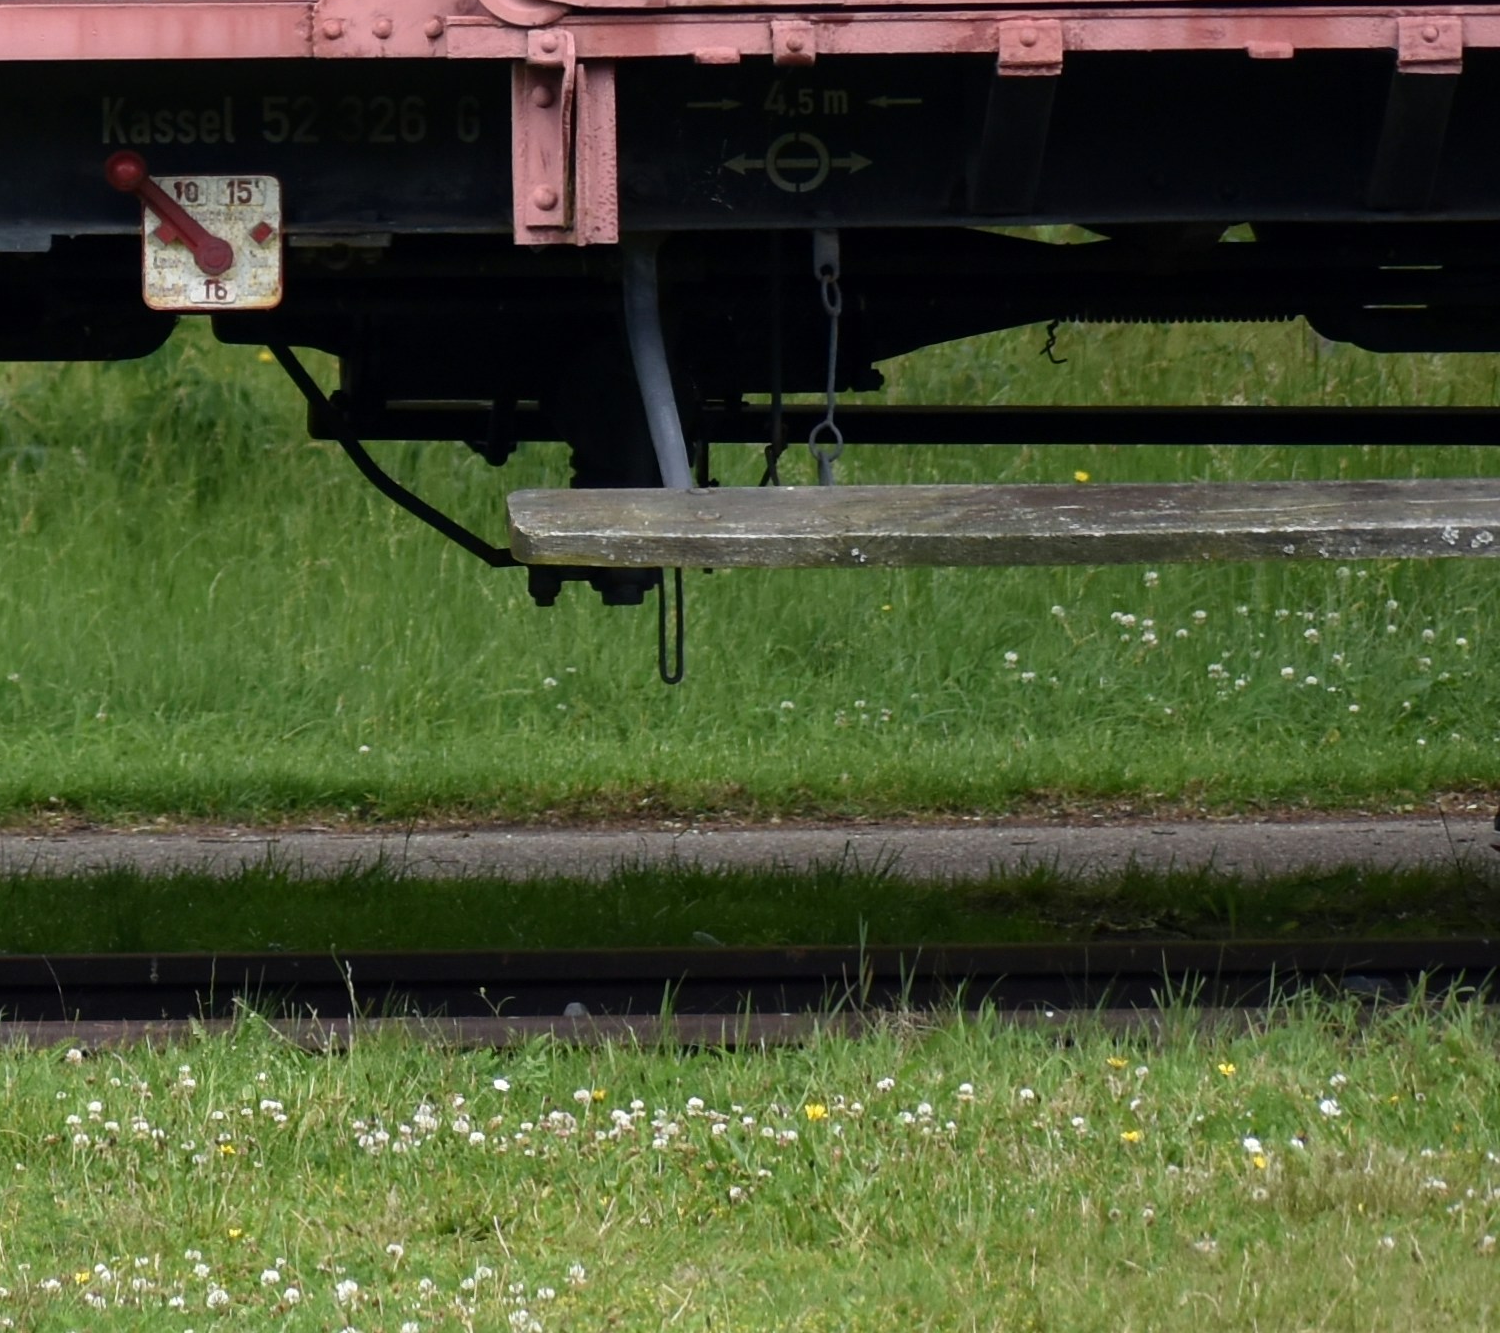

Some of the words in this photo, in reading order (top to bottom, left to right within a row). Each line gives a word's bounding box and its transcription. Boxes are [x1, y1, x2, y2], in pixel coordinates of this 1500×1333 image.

[102, 95, 236, 145] Kassel
[261, 95, 320, 144] 52
[336, 94, 428, 144] 326
[456, 94, 482, 144] G
[823, 88, 849, 115] m
